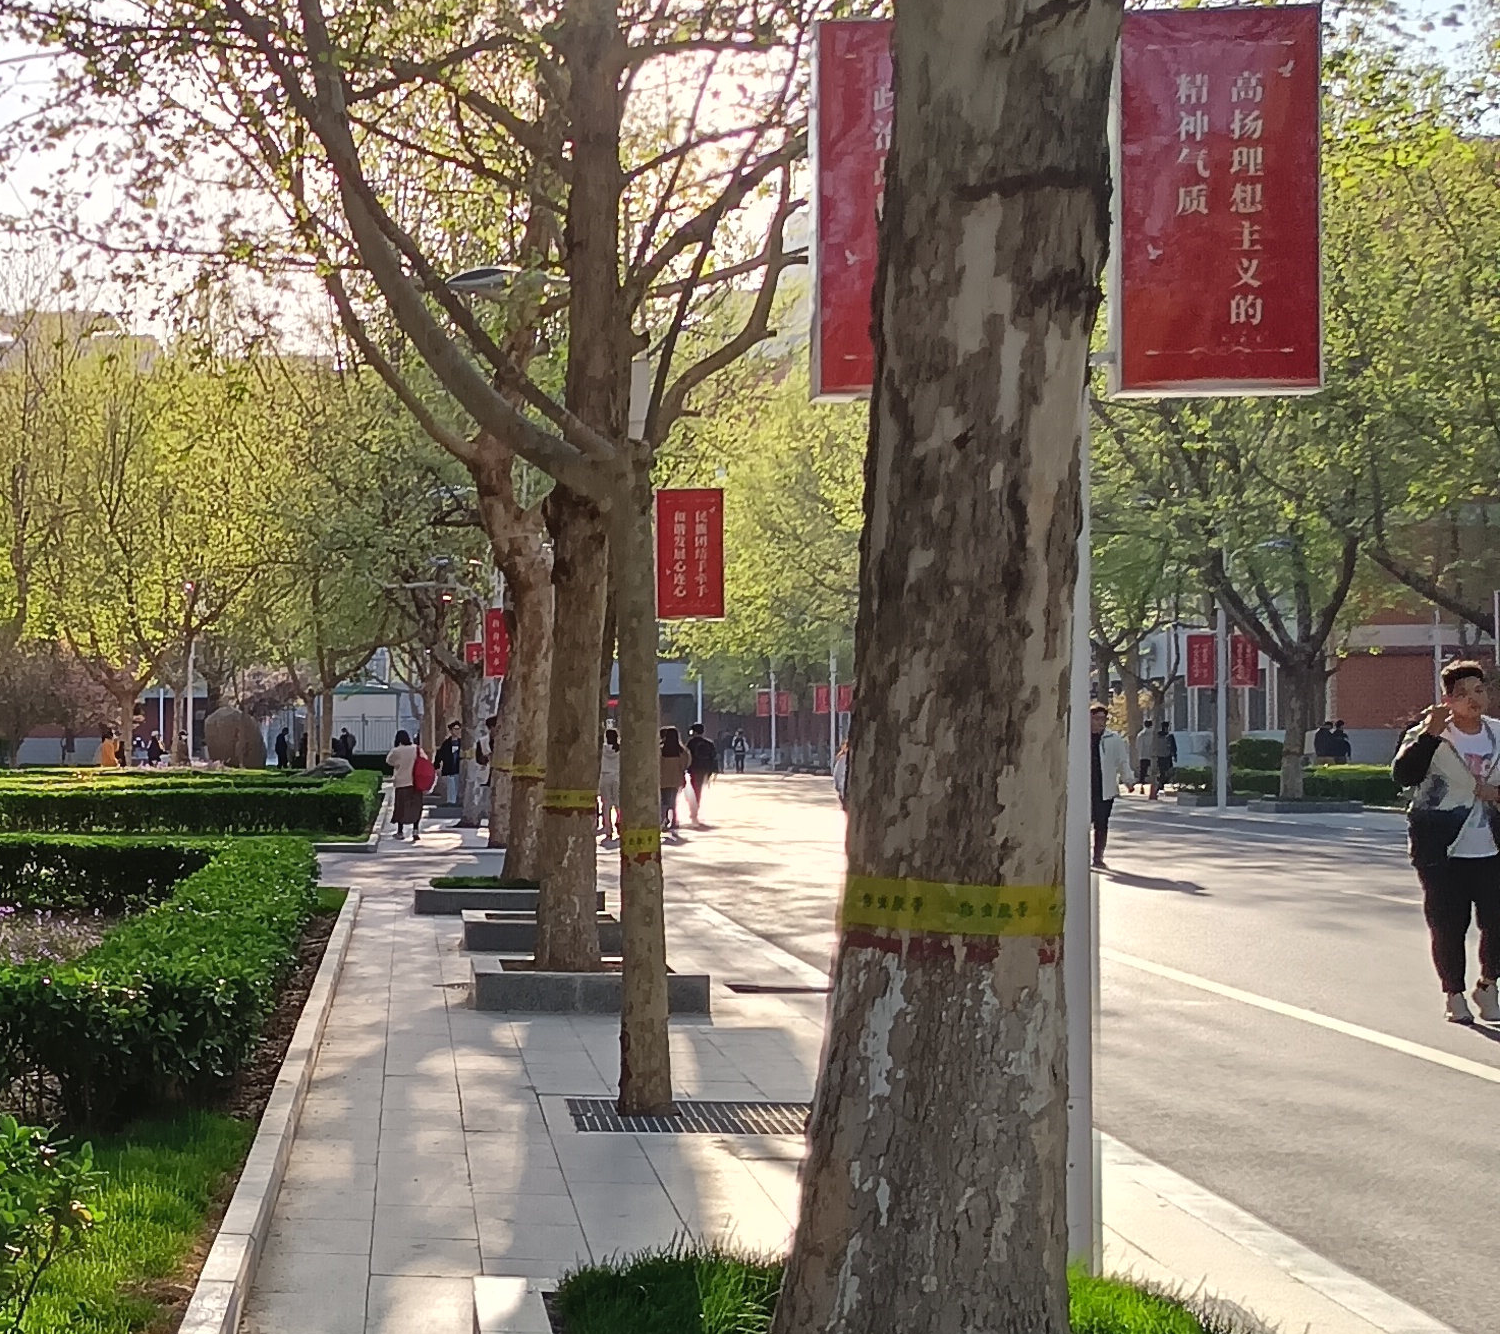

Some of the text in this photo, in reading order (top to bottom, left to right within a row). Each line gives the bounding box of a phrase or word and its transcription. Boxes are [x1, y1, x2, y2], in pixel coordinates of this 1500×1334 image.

[1175, 72, 1211, 217] 精神气质
[1229, 70, 1264, 327] 高扬理想主义的
